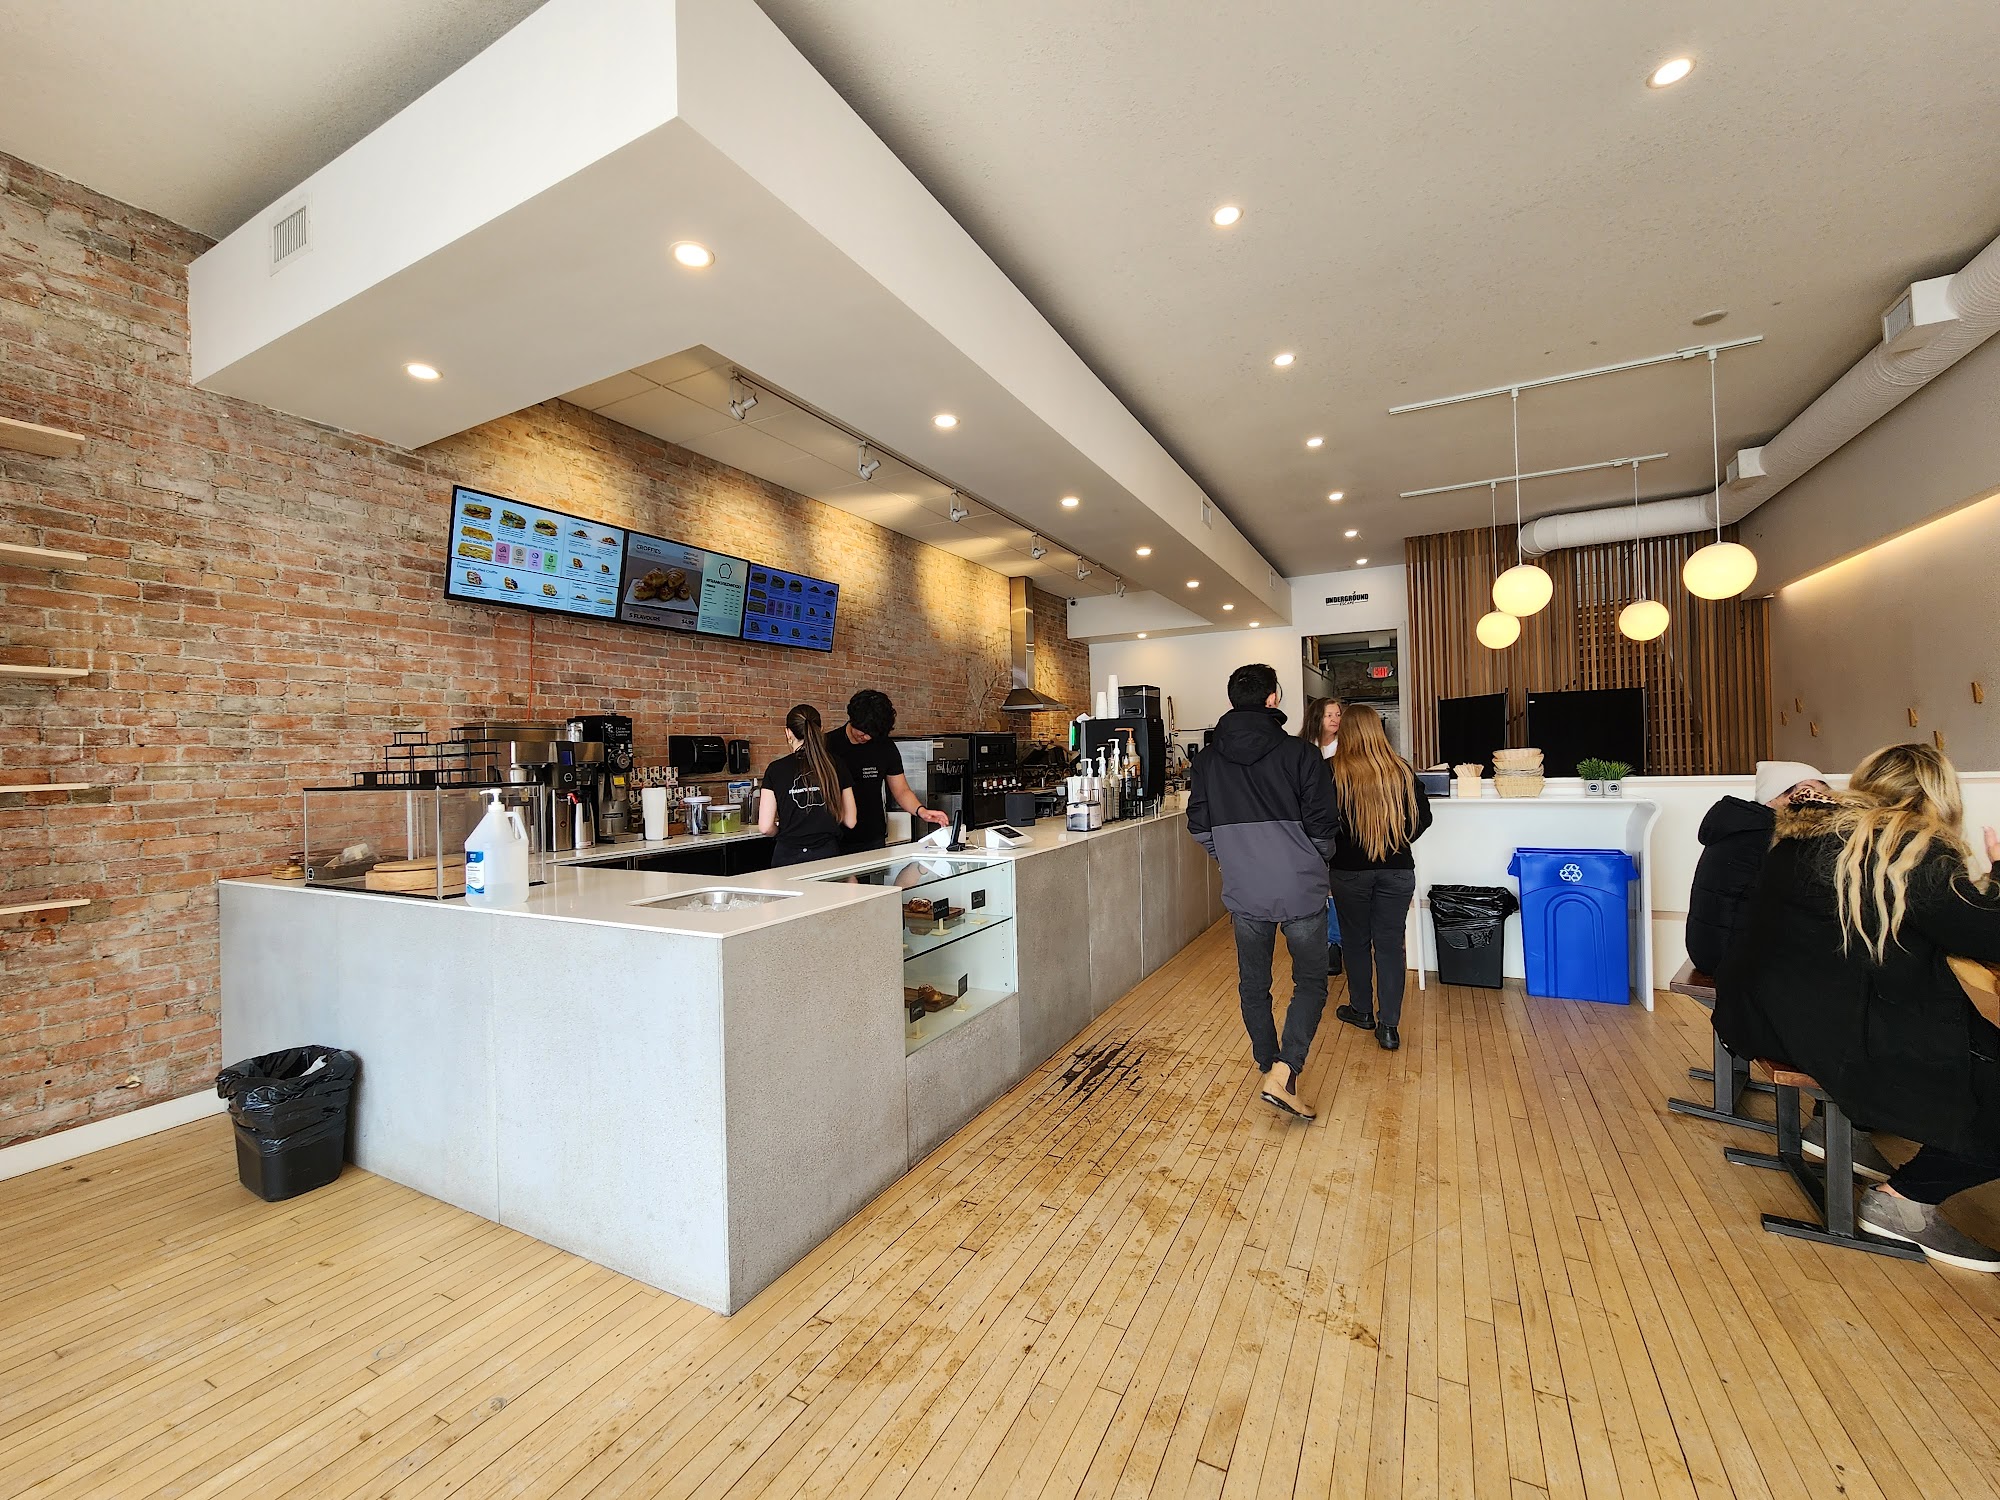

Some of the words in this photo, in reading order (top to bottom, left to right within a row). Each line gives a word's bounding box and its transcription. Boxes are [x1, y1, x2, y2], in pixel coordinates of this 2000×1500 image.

[1325, 593, 1369, 603] UNDERGROUND
[633, 613, 661, 622] FLAVOURS
[1374, 667, 1387, 677] EXIT
